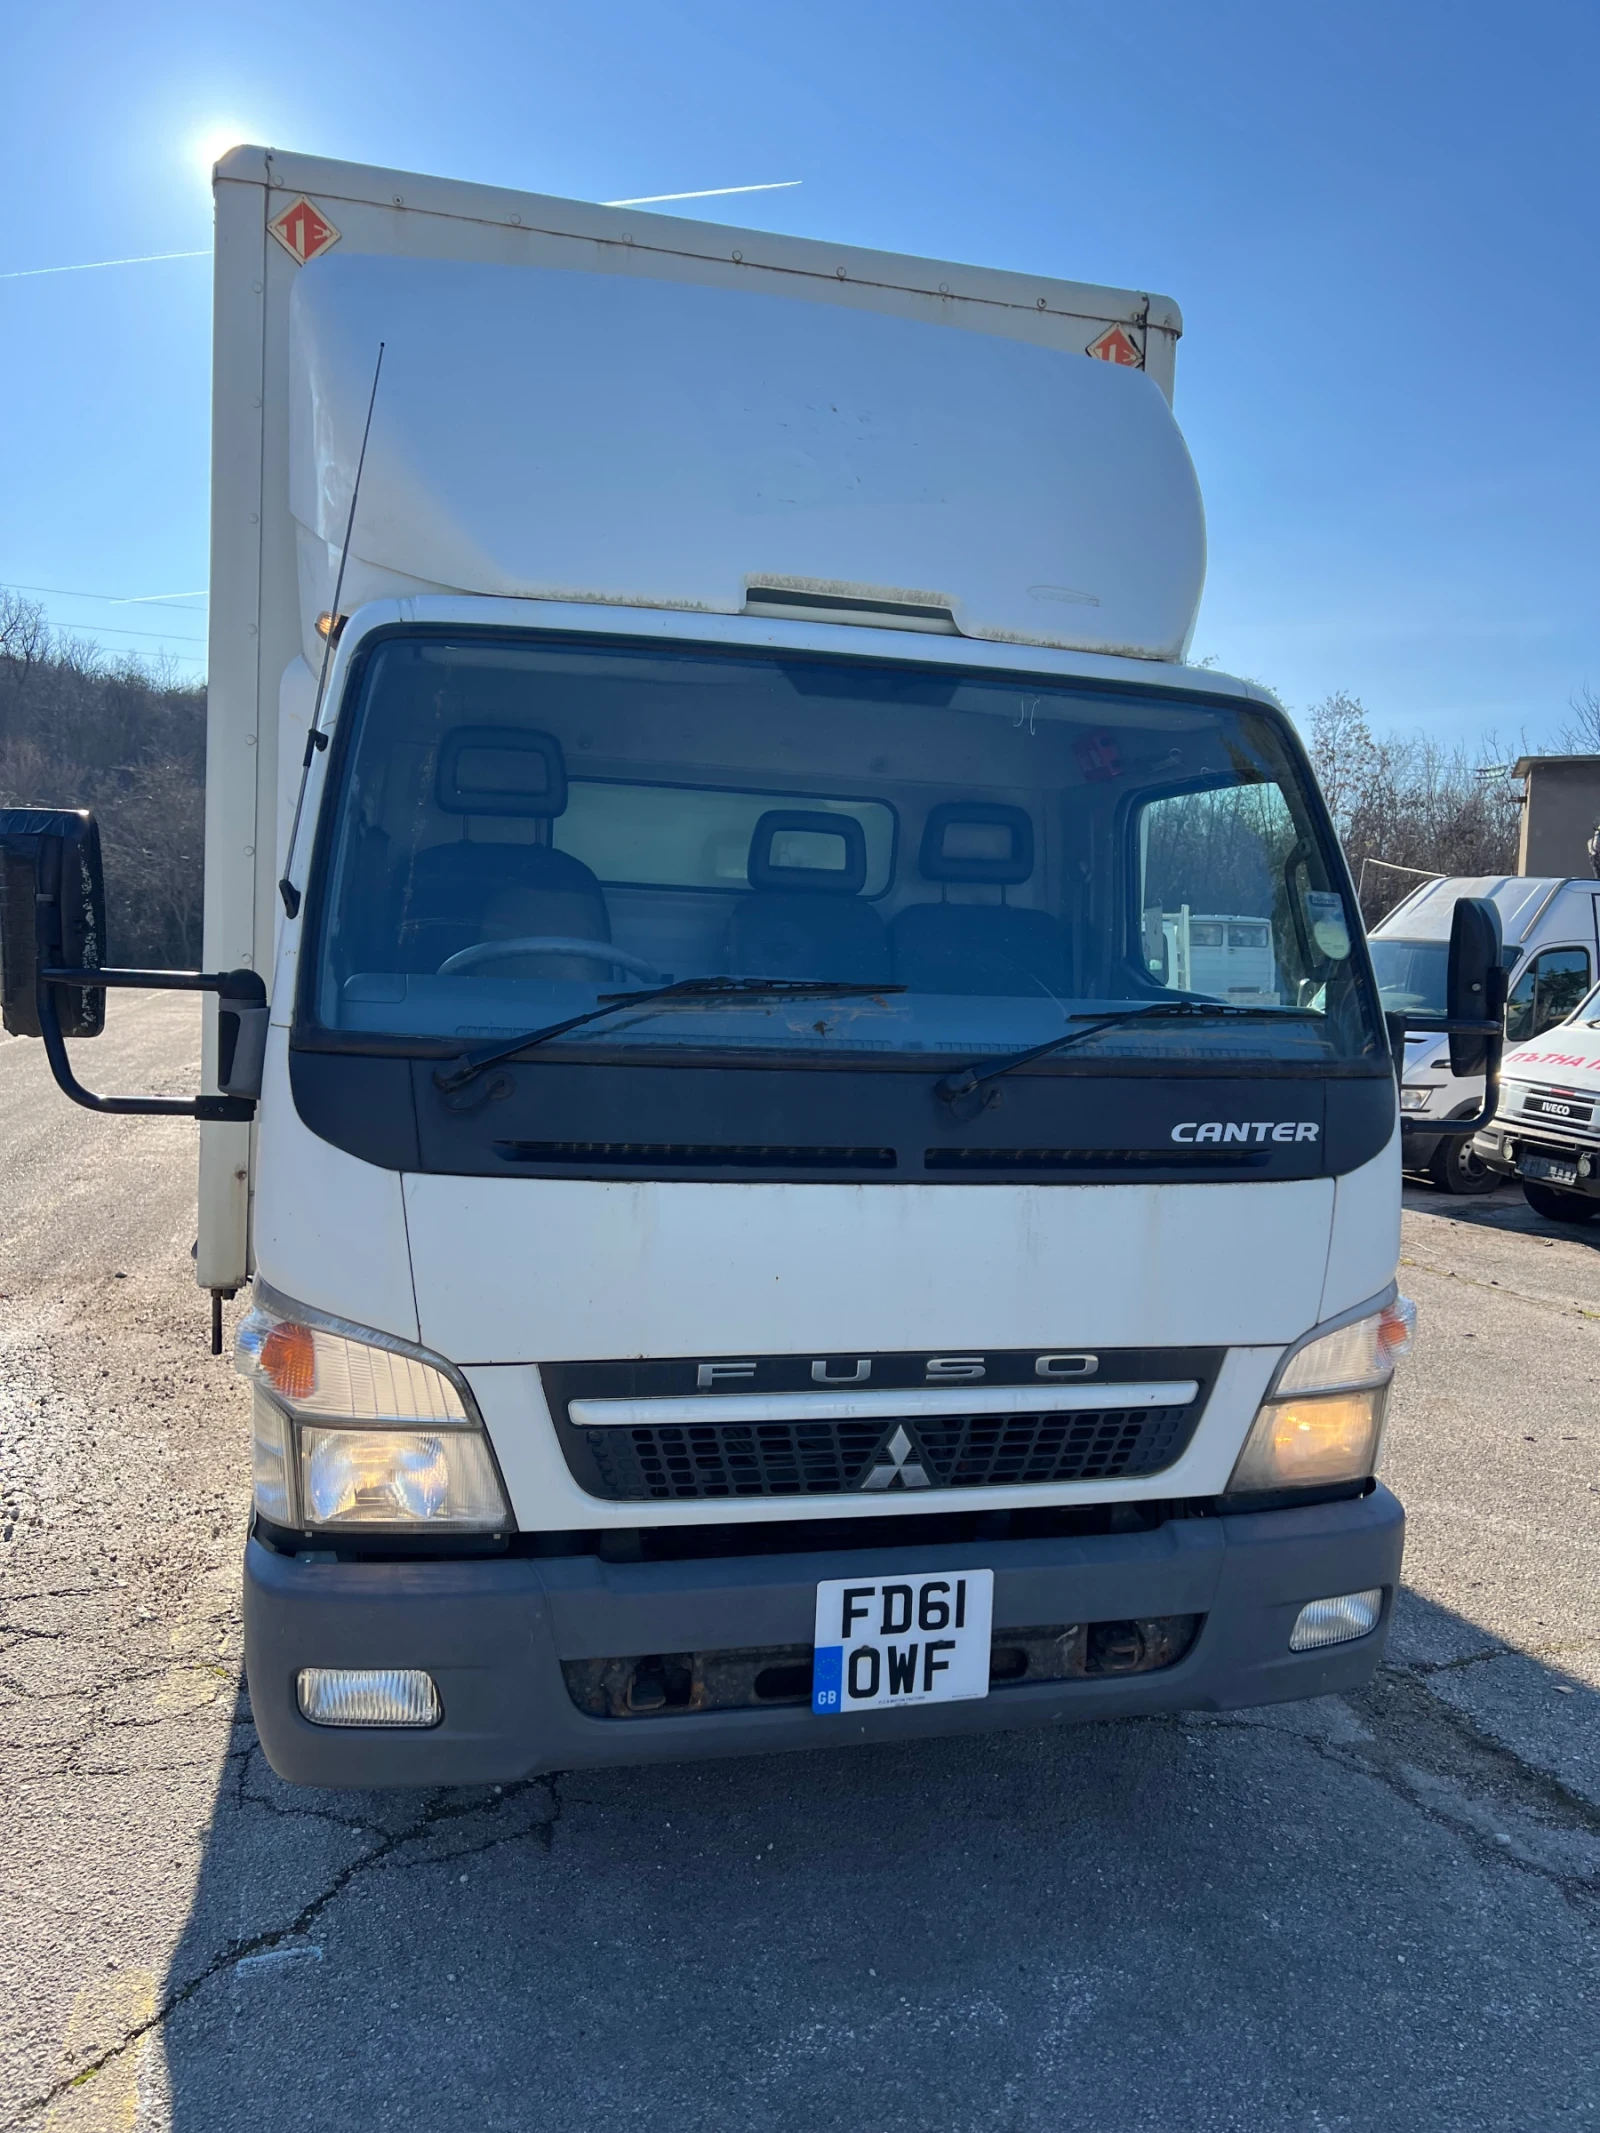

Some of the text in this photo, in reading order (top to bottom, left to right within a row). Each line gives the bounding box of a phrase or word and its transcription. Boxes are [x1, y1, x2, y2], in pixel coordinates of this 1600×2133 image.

[1505, 1052, 1586, 1067] ПЪТНА
[1541, 1101, 1570, 1116] IVECO
[1170, 1122, 1320, 1143] CANTER
[697, 1354, 1099, 1387] FUSO
[841, 1579, 966, 1639] FD61
[848, 1640, 956, 1699] OWF
[817, 1690, 837, 1705] GB
